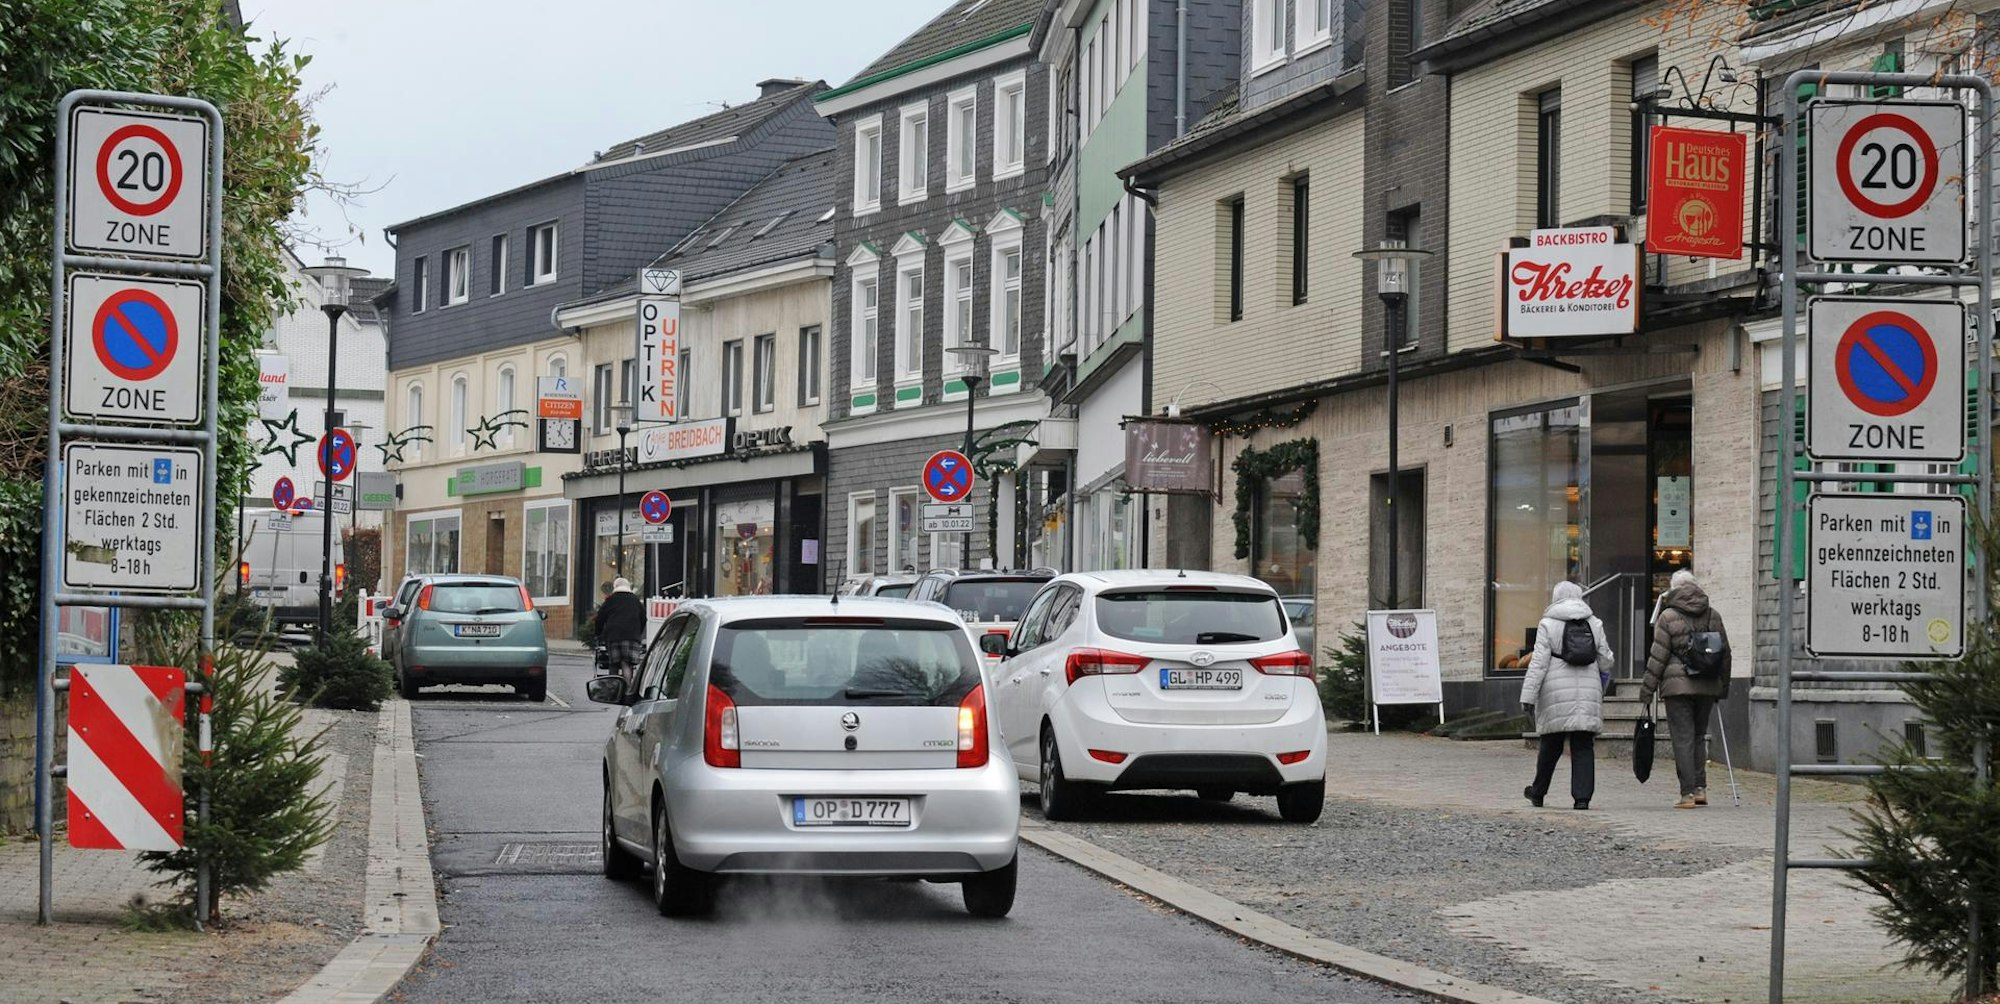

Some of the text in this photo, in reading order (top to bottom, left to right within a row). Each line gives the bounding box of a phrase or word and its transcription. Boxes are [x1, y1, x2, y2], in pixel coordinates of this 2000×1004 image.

[1686, 143, 1731, 156] Deutsches
[117, 149, 164, 191] 20
[1665, 141, 1730, 183] Haus
[1861, 142, 1916, 189] 20
[106, 221, 170, 246] ZONE
[1537, 232, 1608, 246] BACKBISTRO
[1850, 226, 1925, 251] ZONE
[1511, 260, 1633, 309] Kretzer
[1520, 303, 1556, 314] BÄCKEREI
[1567, 302, 1615, 312] KONDITOREI
[641, 304, 658, 402] OPTIK
[661, 318, 676, 417] UHREN
[101, 387, 166, 411] ZONE
[544, 401, 576, 409] CITIZEN
[668, 425, 722, 450] BREIDBACH
[1849, 424, 1925, 449] ZONE
[1142, 449, 1196, 464] liebevoll
[76, 459, 187, 480] Parken mit in
[74, 486, 190, 506] gekennzeichneten
[85, 509, 178, 529] Flächen 2 Std.
[942, 520, 970, 528] 10.01.22
[1820, 513, 1950, 533] Parken mit in
[101, 535, 161, 556] werktags
[1818, 543, 1955, 565] gekennzeichneten
[1831, 570, 1941, 590] Flächen 2 Std.
[1851, 598, 1921, 620] werktags
[1380, 643, 1427, 652] ANGEBOTE
[1169, 672, 1240, 685] GL HP 499
[813, 801, 900, 818] OP D 777
